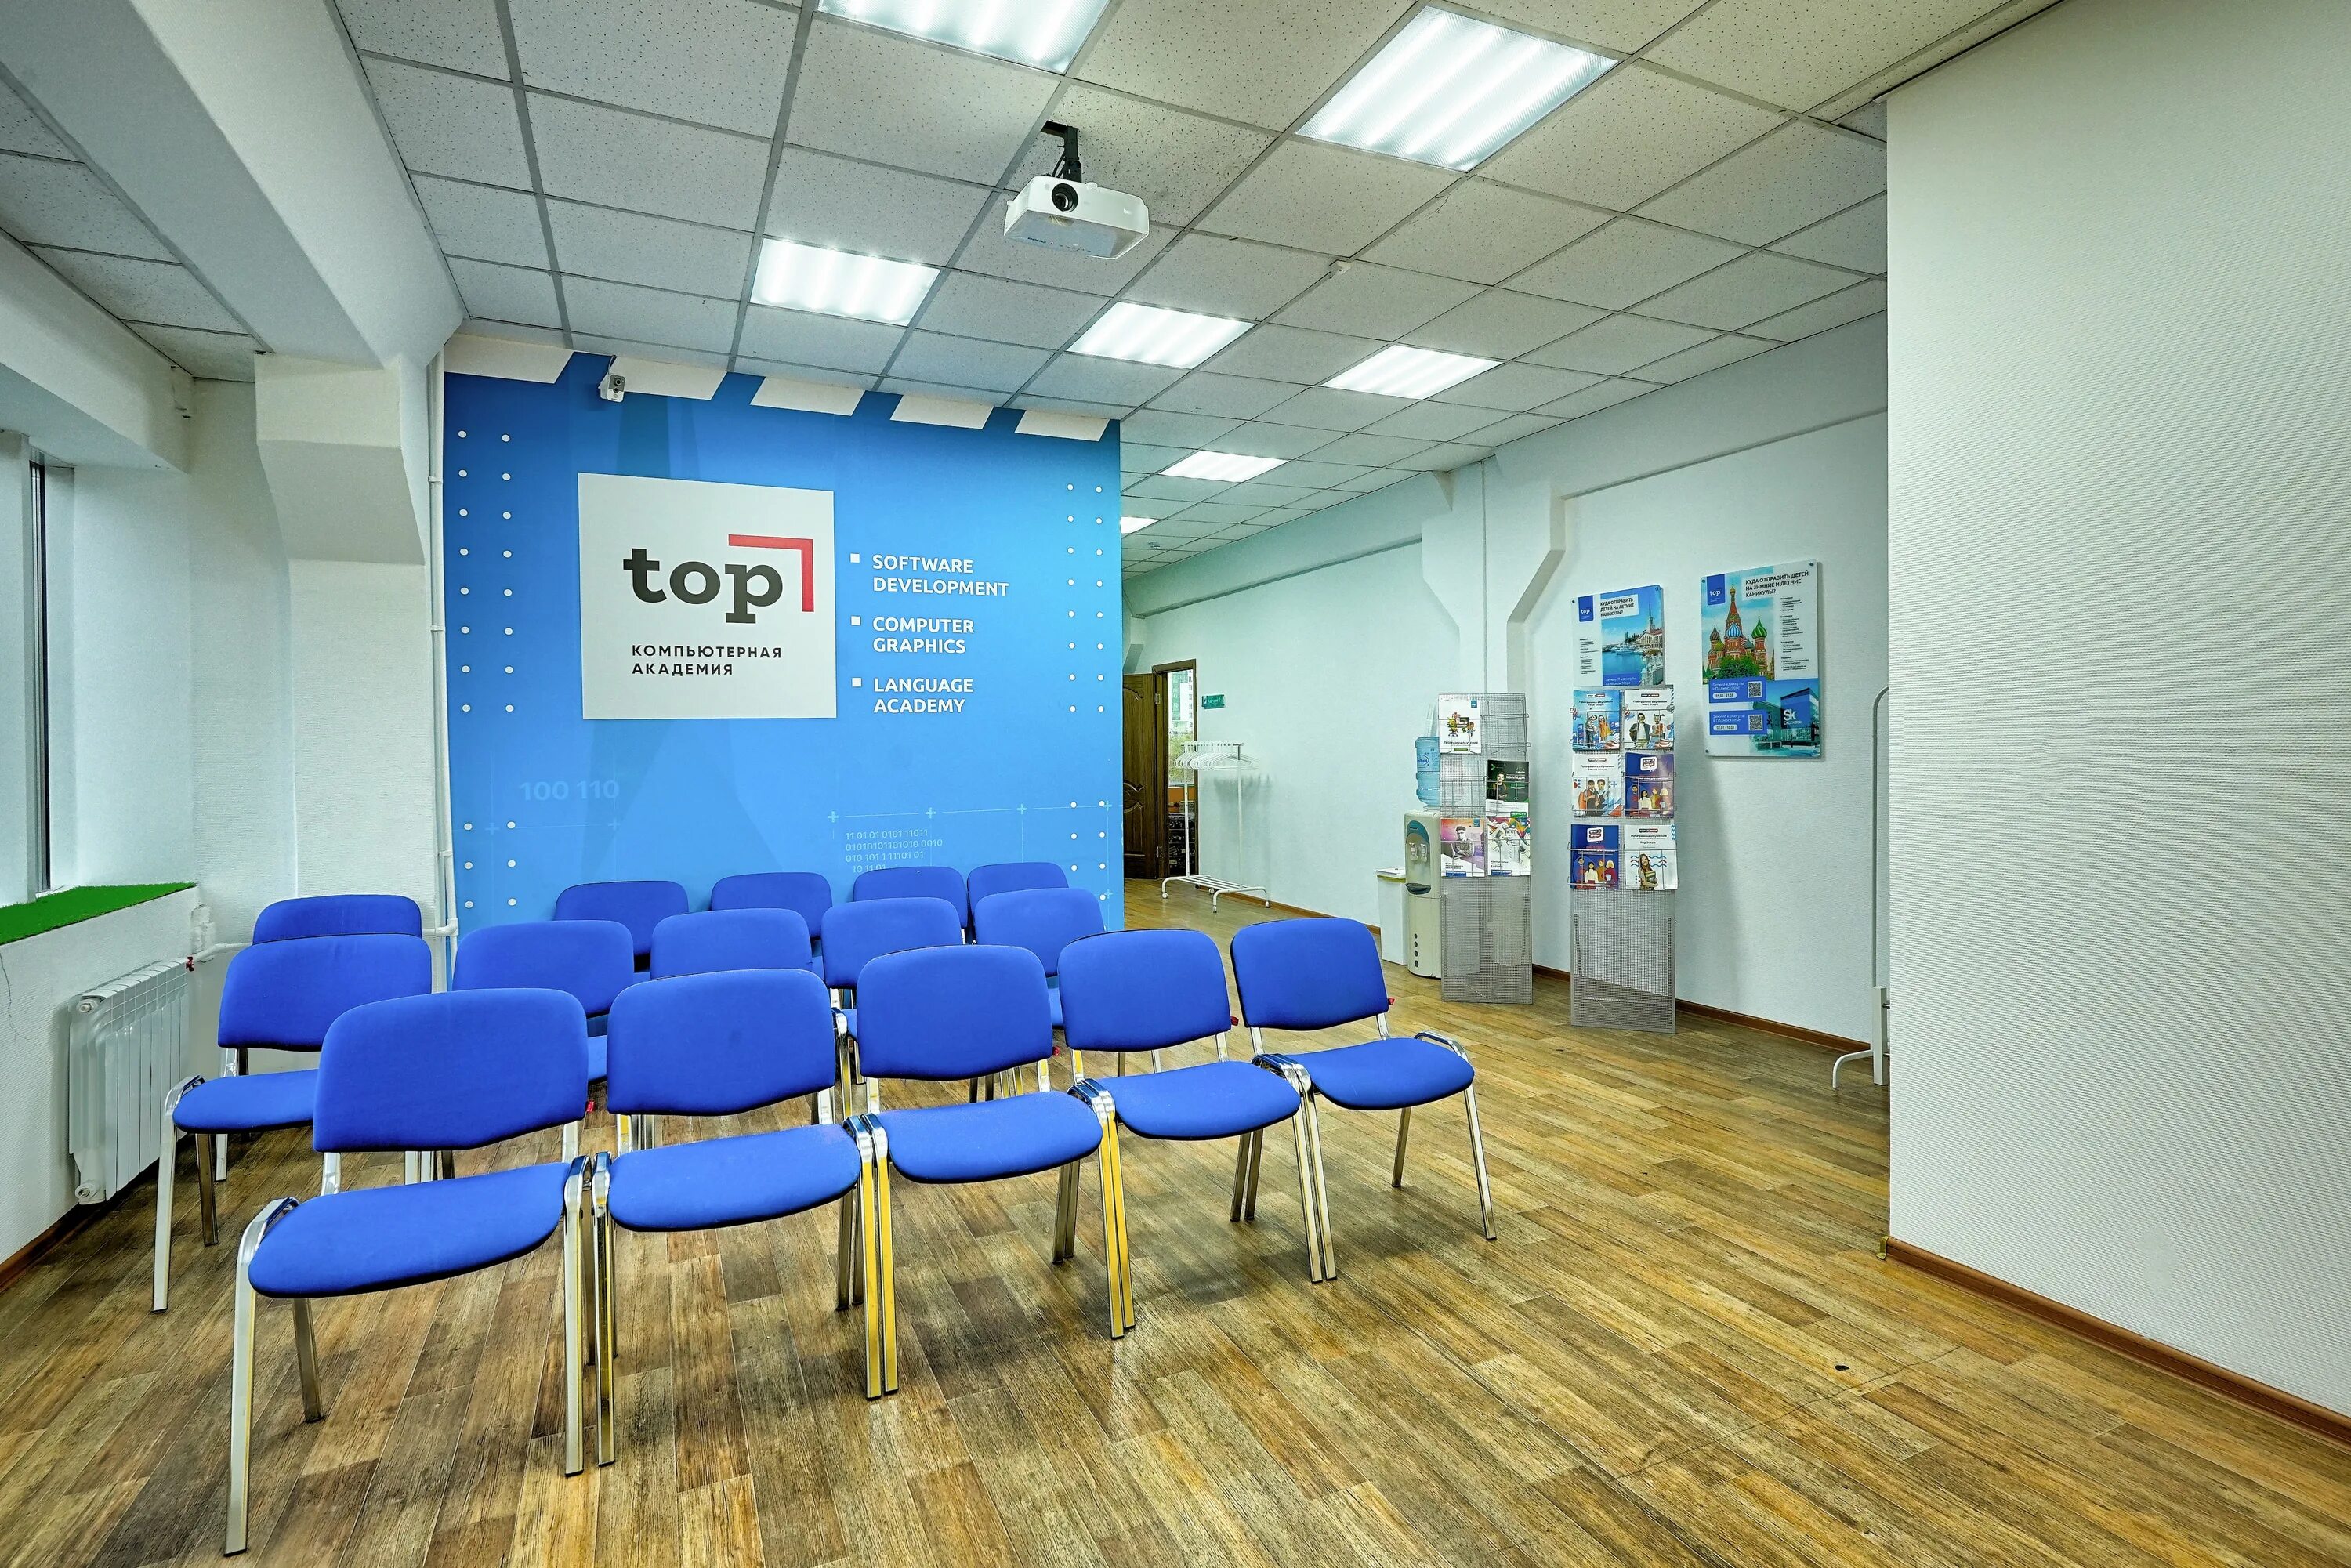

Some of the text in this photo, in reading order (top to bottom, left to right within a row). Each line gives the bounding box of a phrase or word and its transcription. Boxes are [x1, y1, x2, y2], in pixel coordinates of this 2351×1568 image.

[872, 554, 974, 574] SOFTWARE
[1759, 574, 1791, 583] ОТПРАВИТЬ
[1791, 570, 1809, 579] ДЕТЕЙ
[623, 548, 783, 624] top
[873, 577, 1009, 596] DEVELOPMENT
[872, 617, 974, 633] COMPUTER
[632, 645, 782, 659] КОМПЬЮТЕРНАЯ
[872, 637, 966, 654] GRAPHICS
[632, 663, 734, 677] АКАДЕМИЯ
[873, 678, 974, 693] LANGUAGE
[873, 699, 966, 713] ACADEMY
[519, 780, 620, 801] 100 110
[857, 831, 867, 840] 01
[882, 830, 902, 838] 0101
[921, 838, 943, 847] 0010
[846, 854, 863, 863] 010
[865, 853, 879, 861] 101
